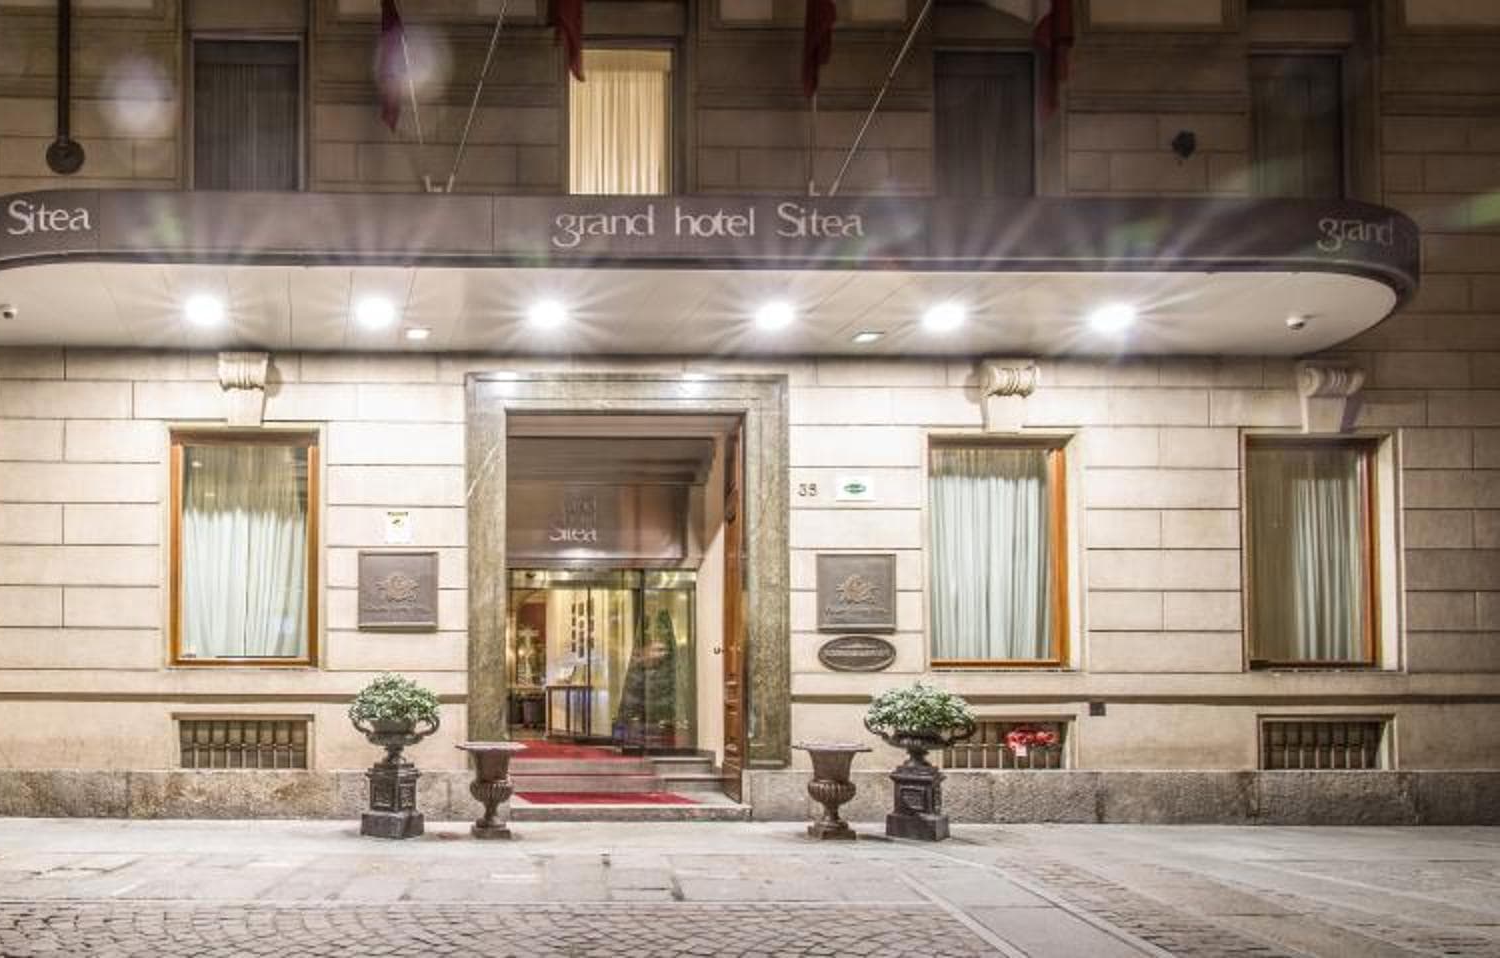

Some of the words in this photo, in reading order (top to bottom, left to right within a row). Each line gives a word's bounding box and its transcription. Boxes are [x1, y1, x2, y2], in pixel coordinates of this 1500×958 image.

[7, 200, 92, 235] Sitea
[552, 204, 655, 248] grand
[675, 206, 756, 237] hotel
[776, 202, 865, 237] Sitea
[1316, 215, 1394, 252] grand
